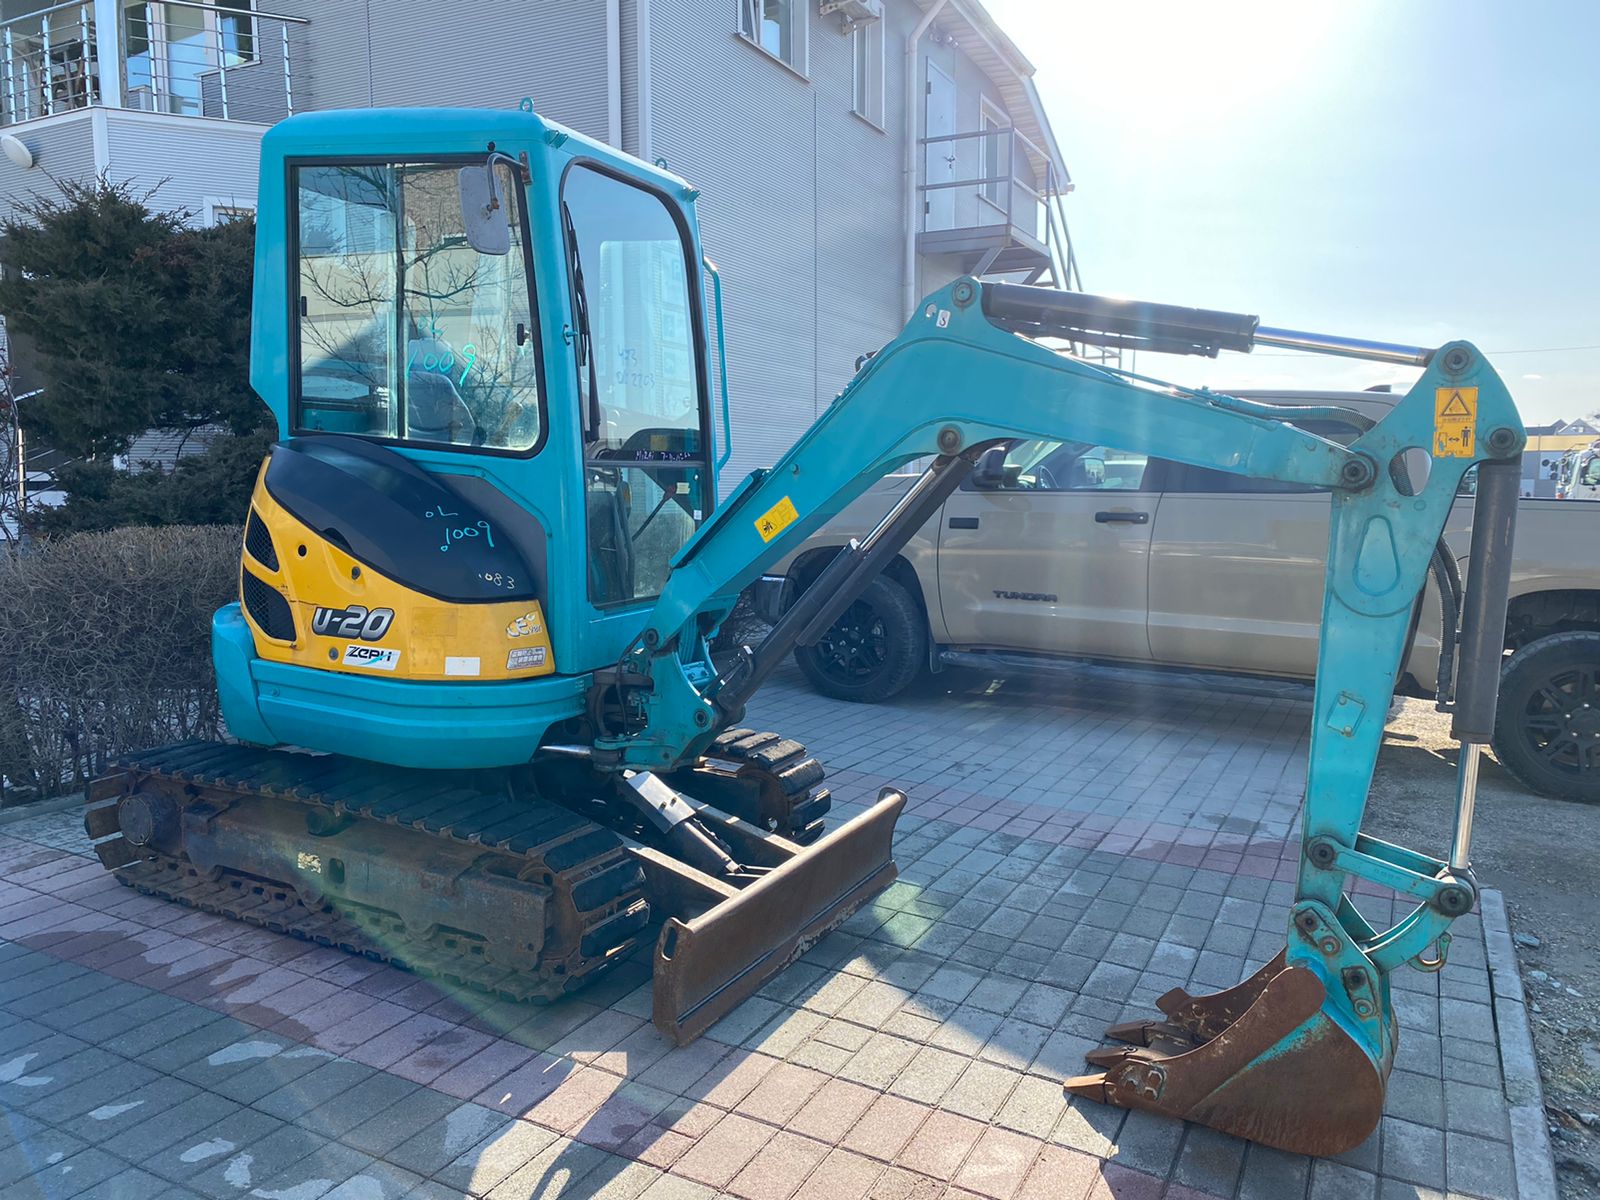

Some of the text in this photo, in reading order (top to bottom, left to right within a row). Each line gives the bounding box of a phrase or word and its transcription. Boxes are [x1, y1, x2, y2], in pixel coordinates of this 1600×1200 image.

[406, 343, 476, 387] 1009
[993, 590, 1058, 603] TUNDRA
[312, 604, 395, 641] U-20
